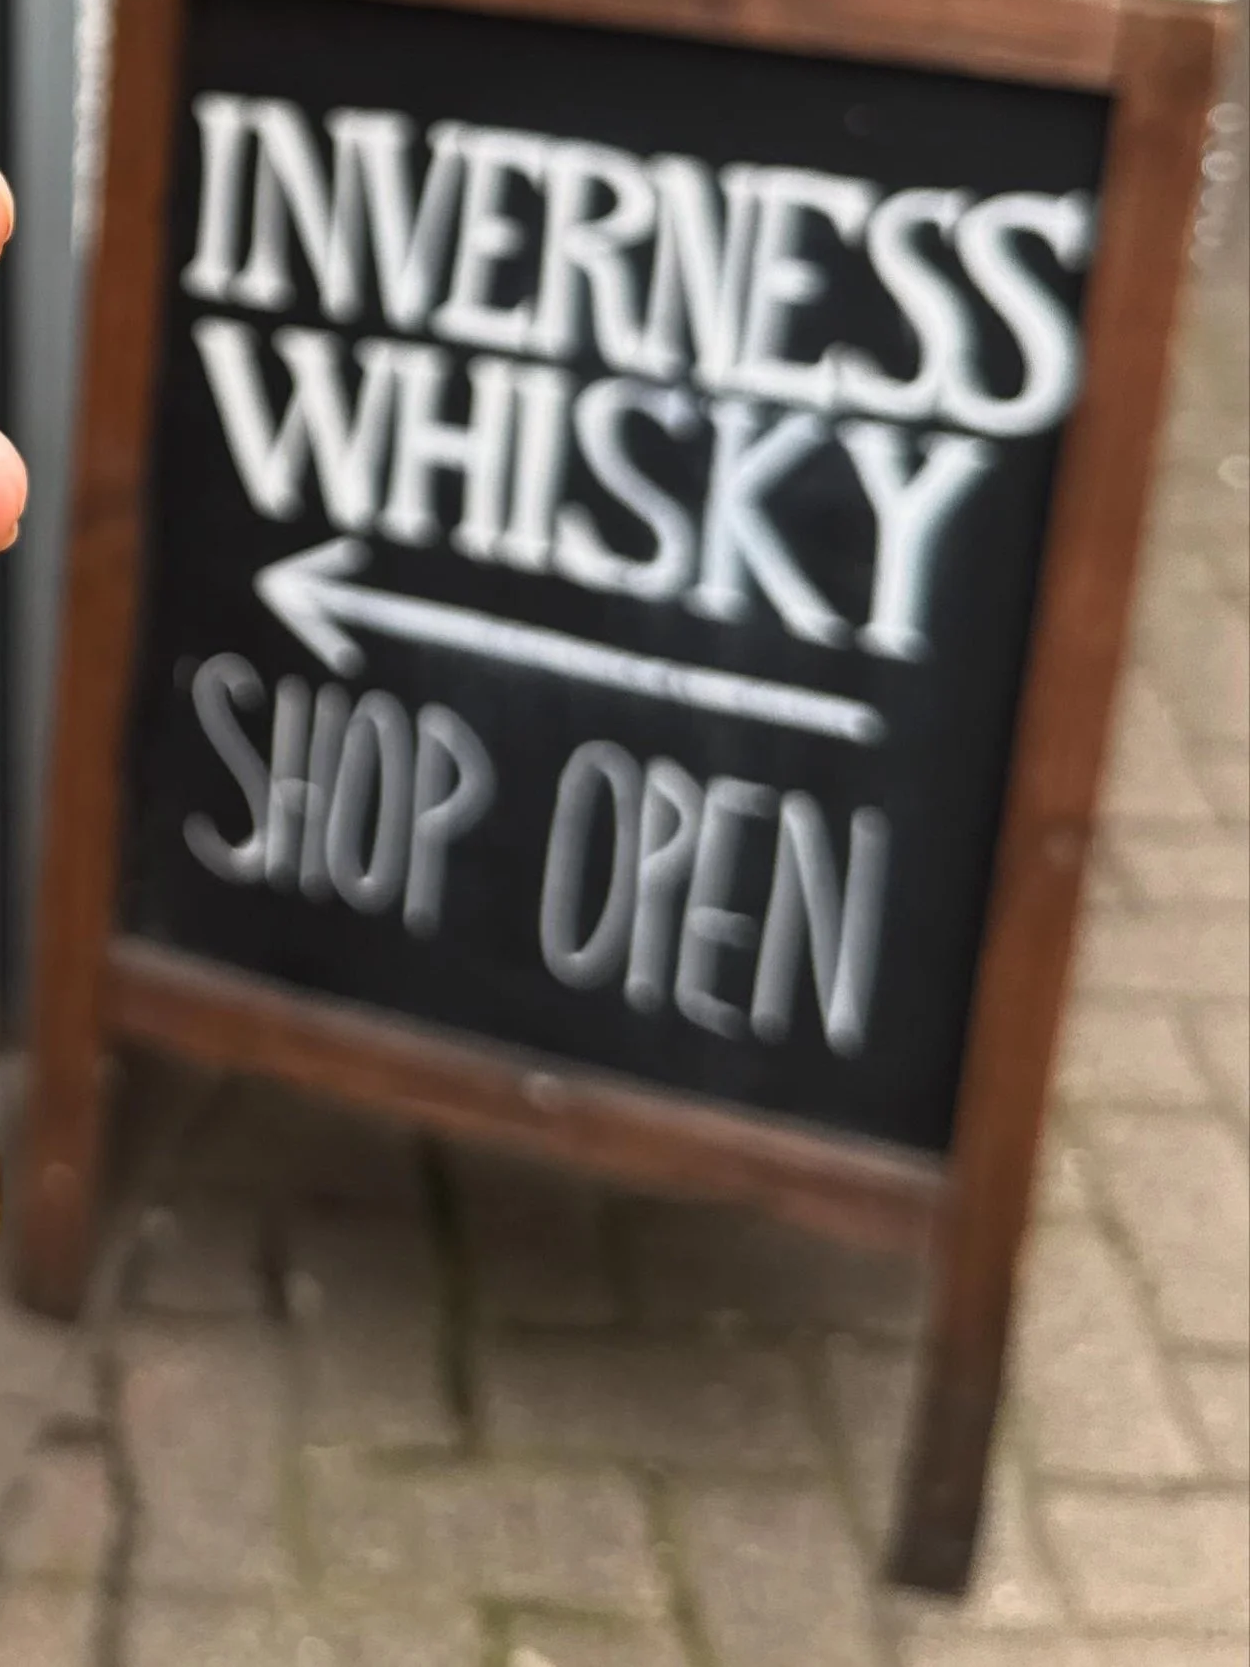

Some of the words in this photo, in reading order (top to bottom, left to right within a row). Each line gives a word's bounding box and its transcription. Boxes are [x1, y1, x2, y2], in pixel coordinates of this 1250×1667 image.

[180, 91, 1097, 437] INVERNESS
[190, 315, 990, 659] WHISKY
[182, 652, 498, 936] SHOP
[538, 738, 891, 1056] OPEN
